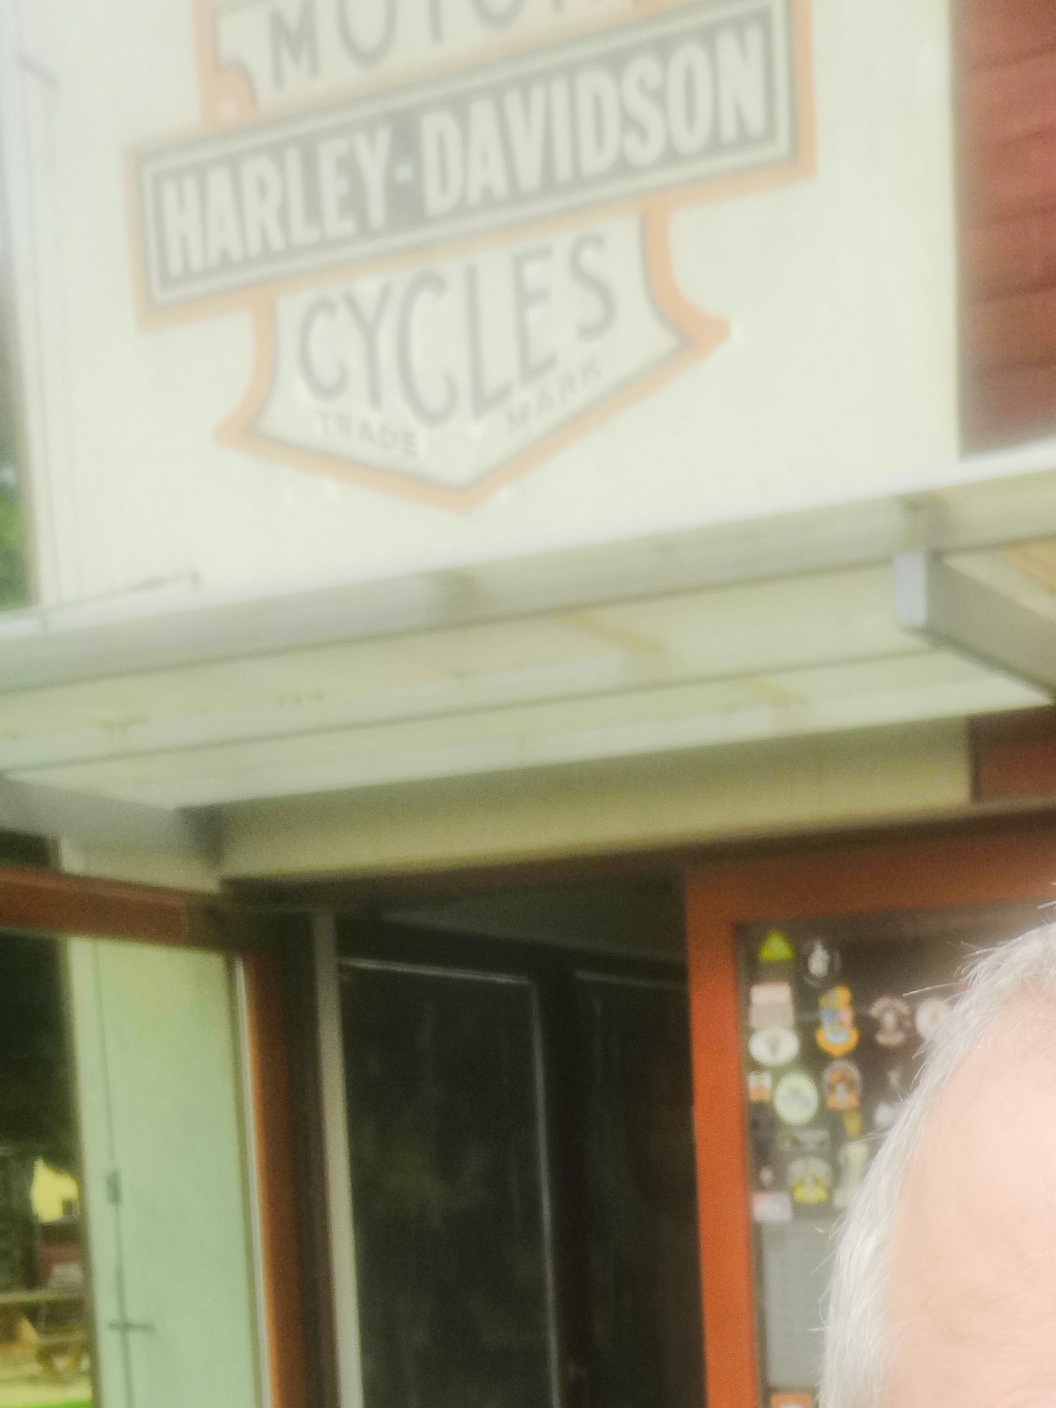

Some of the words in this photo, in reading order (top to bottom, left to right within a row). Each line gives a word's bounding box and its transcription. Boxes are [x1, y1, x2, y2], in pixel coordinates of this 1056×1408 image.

[298, 232, 617, 428] CYCLES
[316, 408, 419, 458] TRADE
[505, 356, 604, 436] MARK
